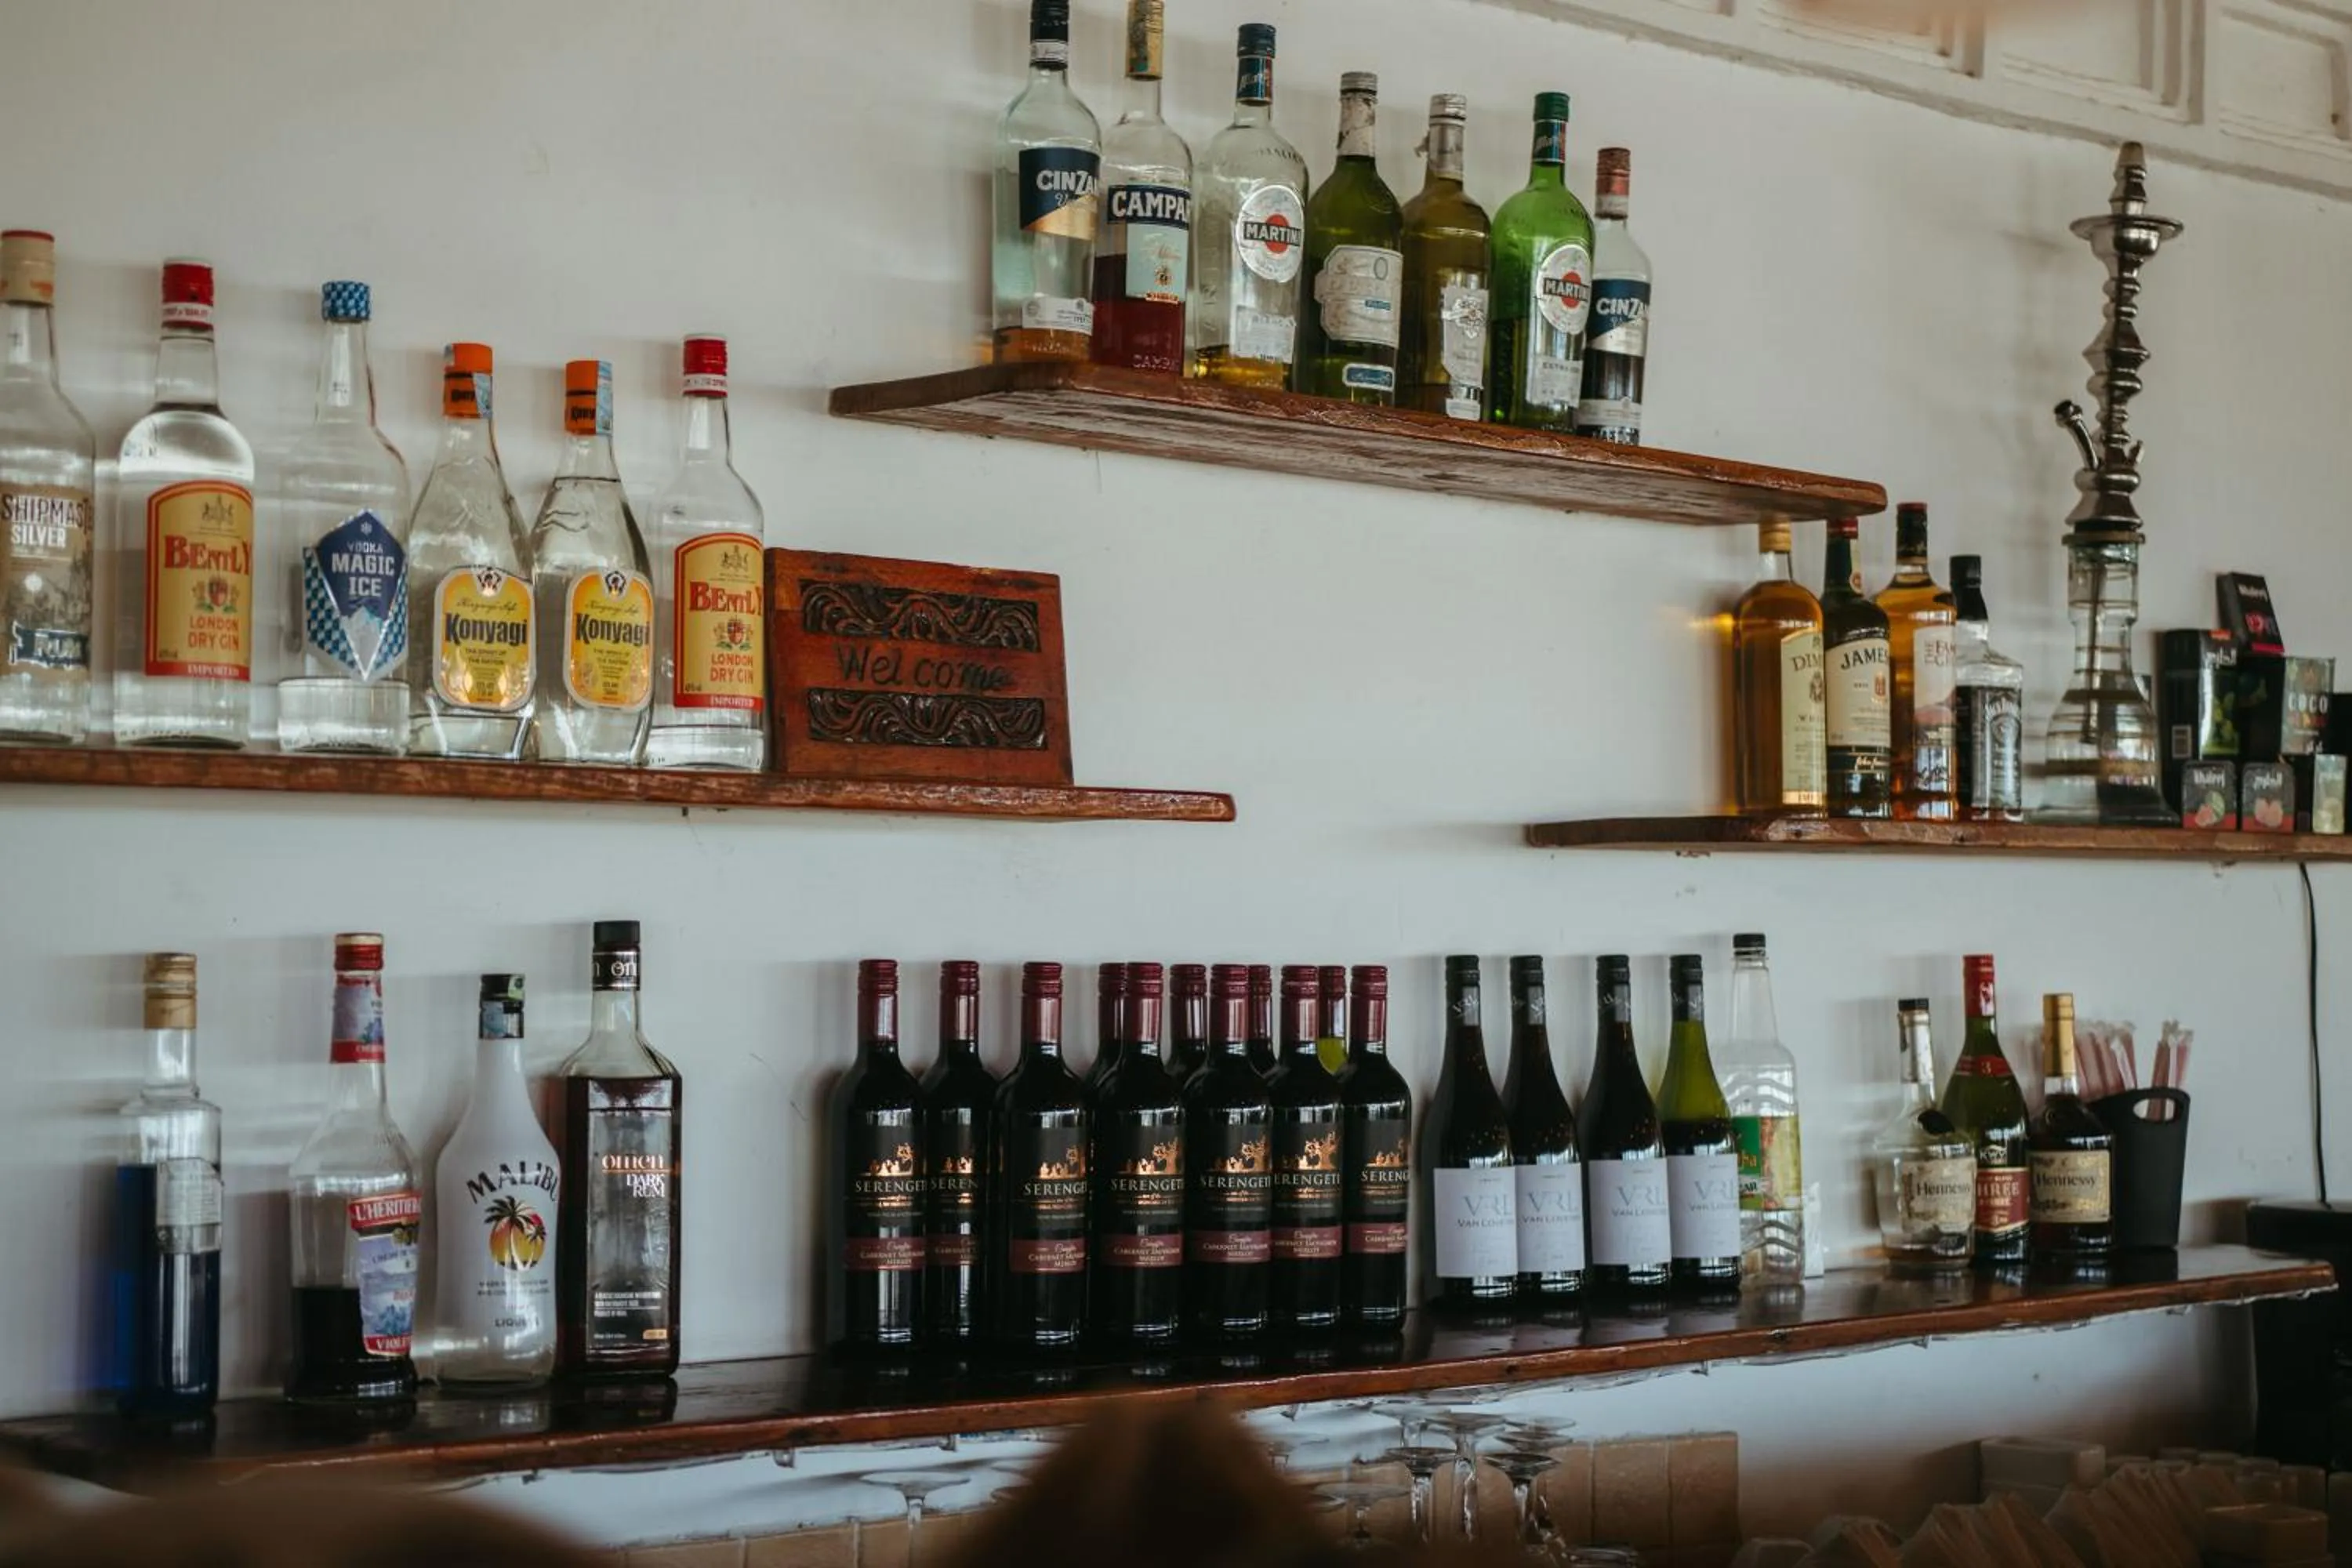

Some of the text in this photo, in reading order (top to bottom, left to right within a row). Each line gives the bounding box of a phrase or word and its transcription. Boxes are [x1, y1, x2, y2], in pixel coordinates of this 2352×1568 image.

[11, 524, 66, 548] SILVER
[347, 541, 383, 554] VODKA
[332, 552, 395, 576] MAGIC
[349, 576, 383, 597] ICE
[190, 615, 239, 631] LONDON
[445, 612, 528, 646] Konyagi
[575, 612, 650, 647] Konyagi
[188, 631, 239, 651] DRY GIN
[710, 652, 754, 666] LONDON
[710, 666, 754, 684] DRY GIN
[1981, 1062, 1991, 1074] 3
[626, 1173, 665, 1186] DARK
[1274, 1172, 1341, 1186] ERENGETI
[2036, 1172, 2096, 1189] Hennessy
[633, 1184, 665, 1199] RUM
[1976, 1181, 2020, 1197] HREE
